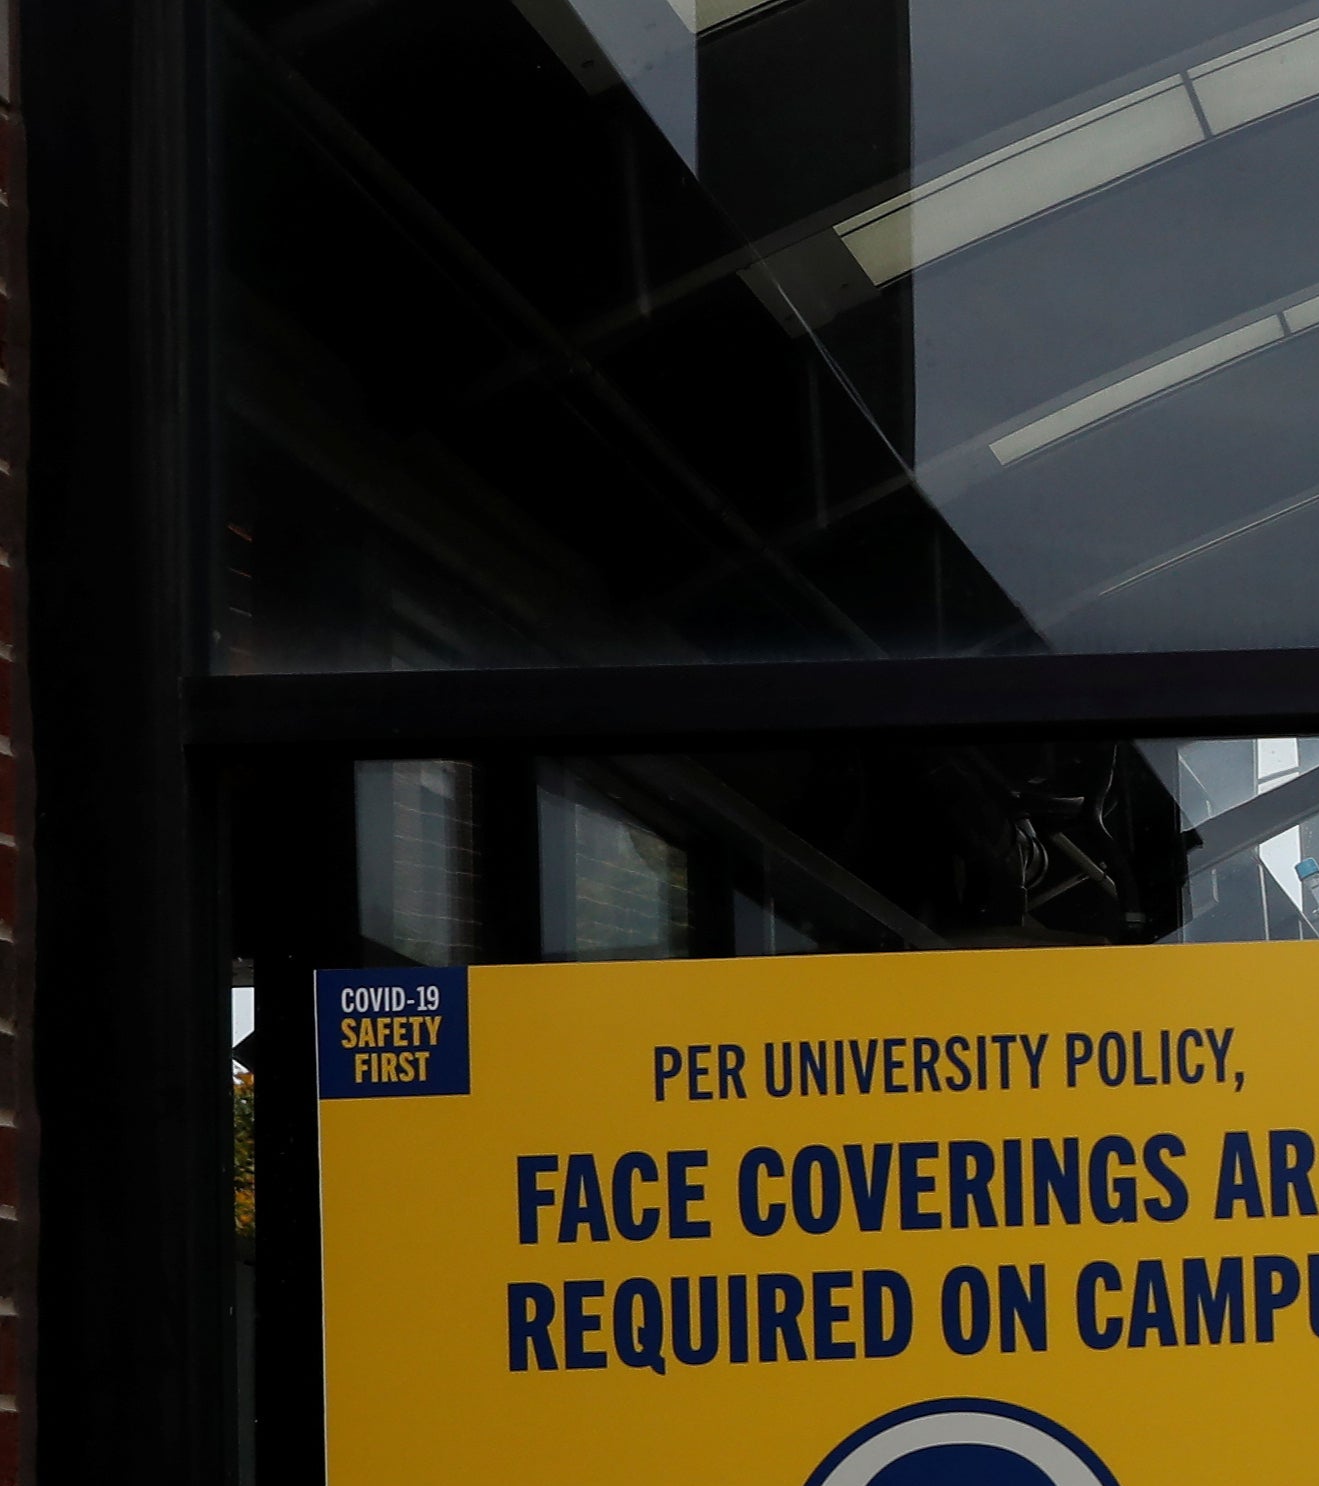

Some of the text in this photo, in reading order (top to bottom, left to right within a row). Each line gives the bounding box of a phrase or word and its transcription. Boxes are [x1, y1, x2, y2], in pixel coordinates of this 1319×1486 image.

[341, 985, 440, 1013] COVID-19
[341, 1015, 442, 1049] SAFETY
[354, 1051, 430, 1084] FIRST
[654, 1027, 1245, 1102] PER UNIVERSITY POLICY,
[516, 1149, 712, 1245] FACE
[738, 1133, 1189, 1237] COVERINGS
[507, 1269, 914, 1376] REQUIRED
[940, 1263, 1048, 1356] ON
